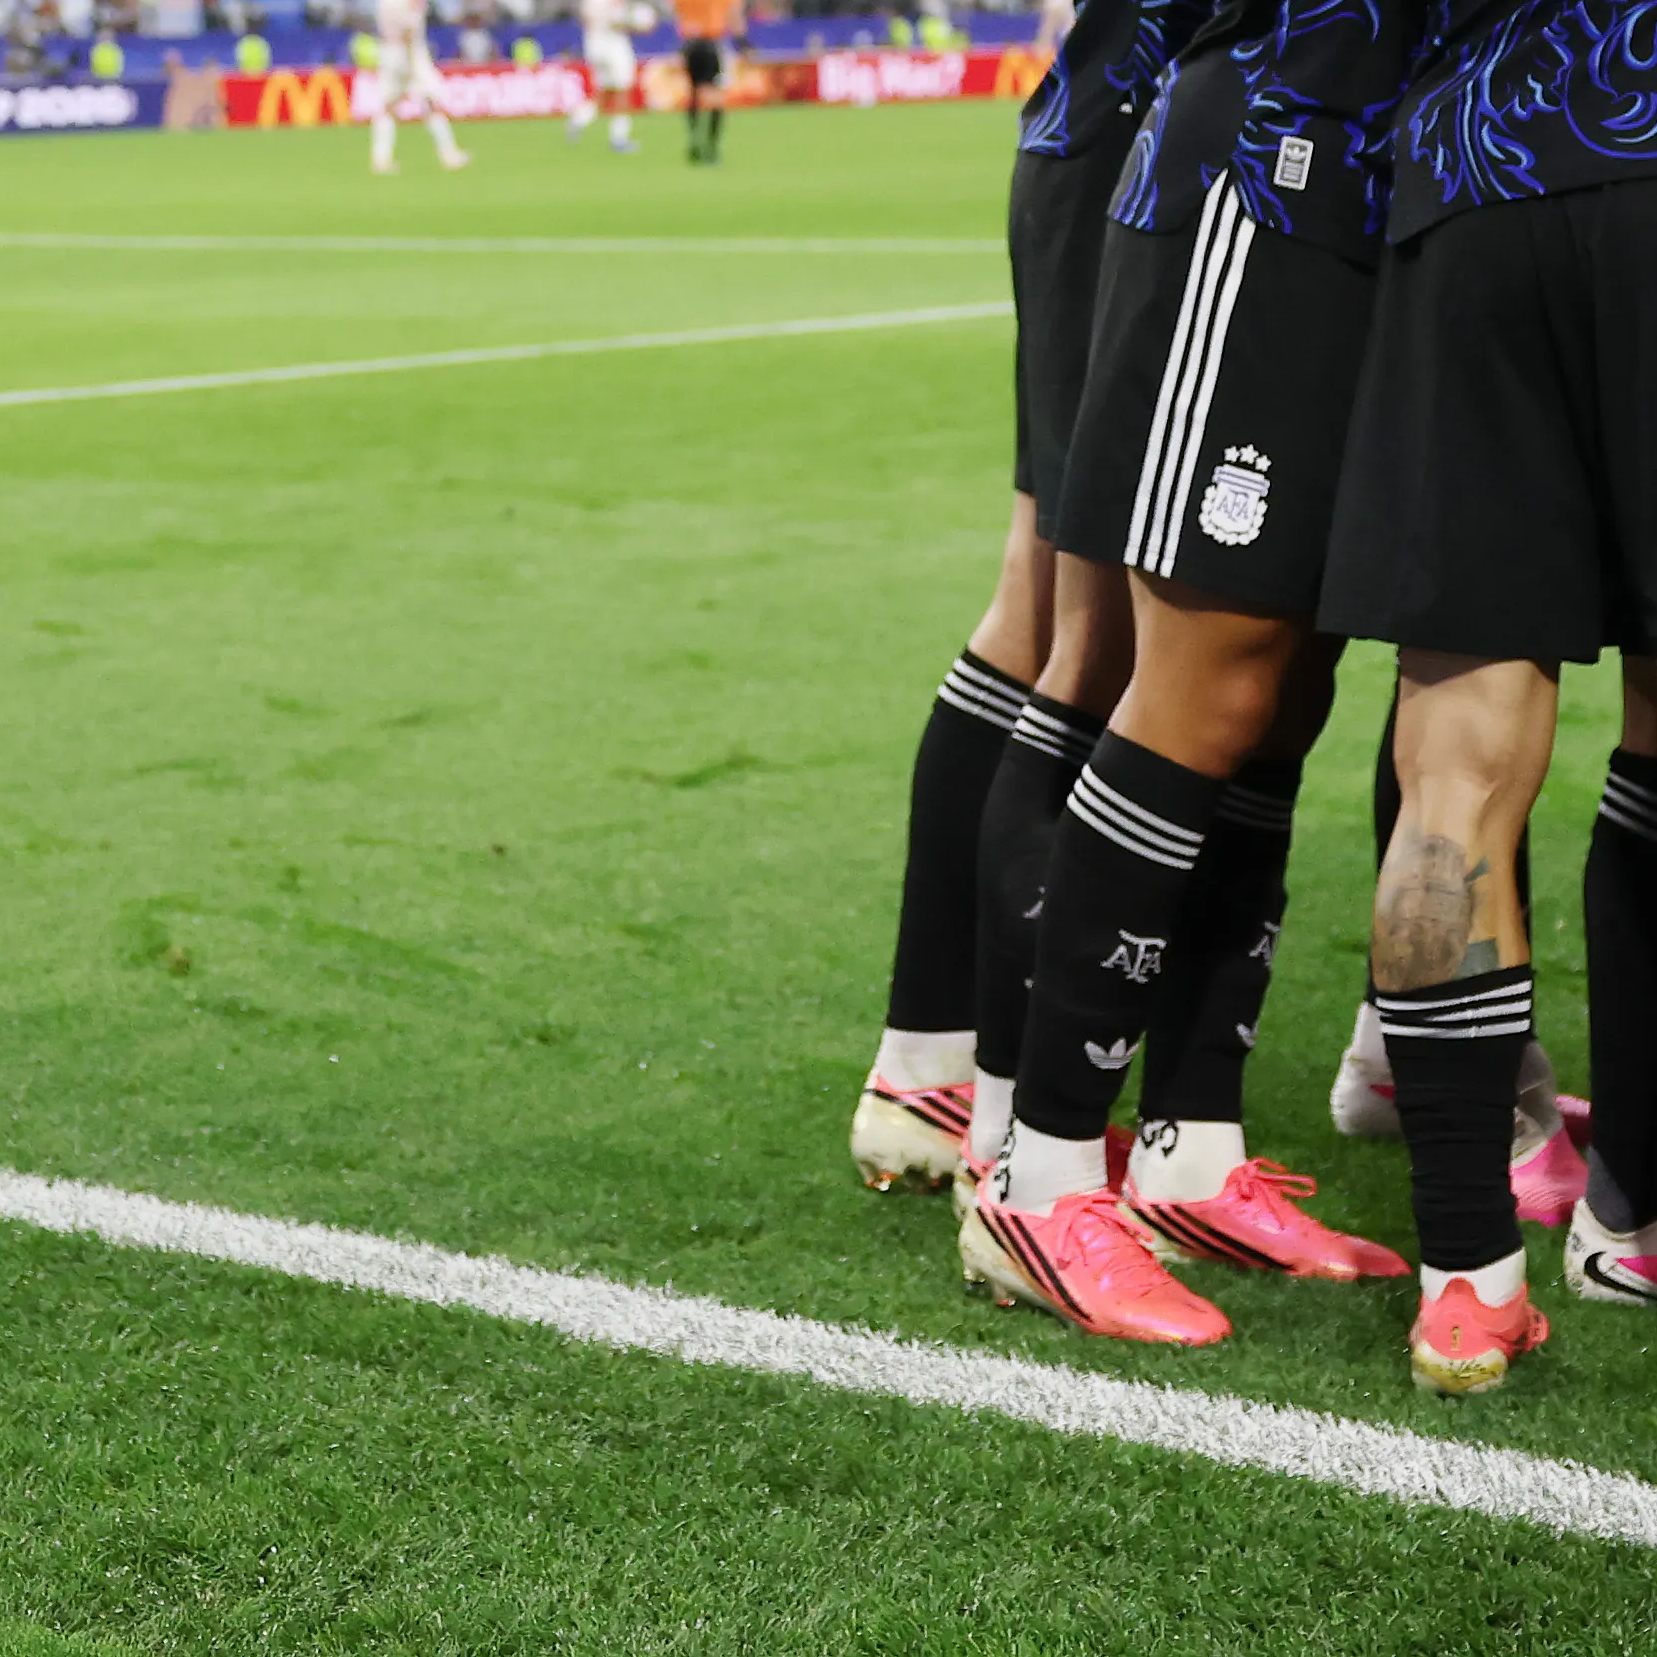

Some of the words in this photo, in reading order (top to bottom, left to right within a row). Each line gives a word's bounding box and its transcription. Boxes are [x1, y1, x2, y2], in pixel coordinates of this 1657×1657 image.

[352, 64, 584, 120] Monald's
[1216, 487, 1250, 523] AFA
[1099, 927, 1168, 984] AFA
